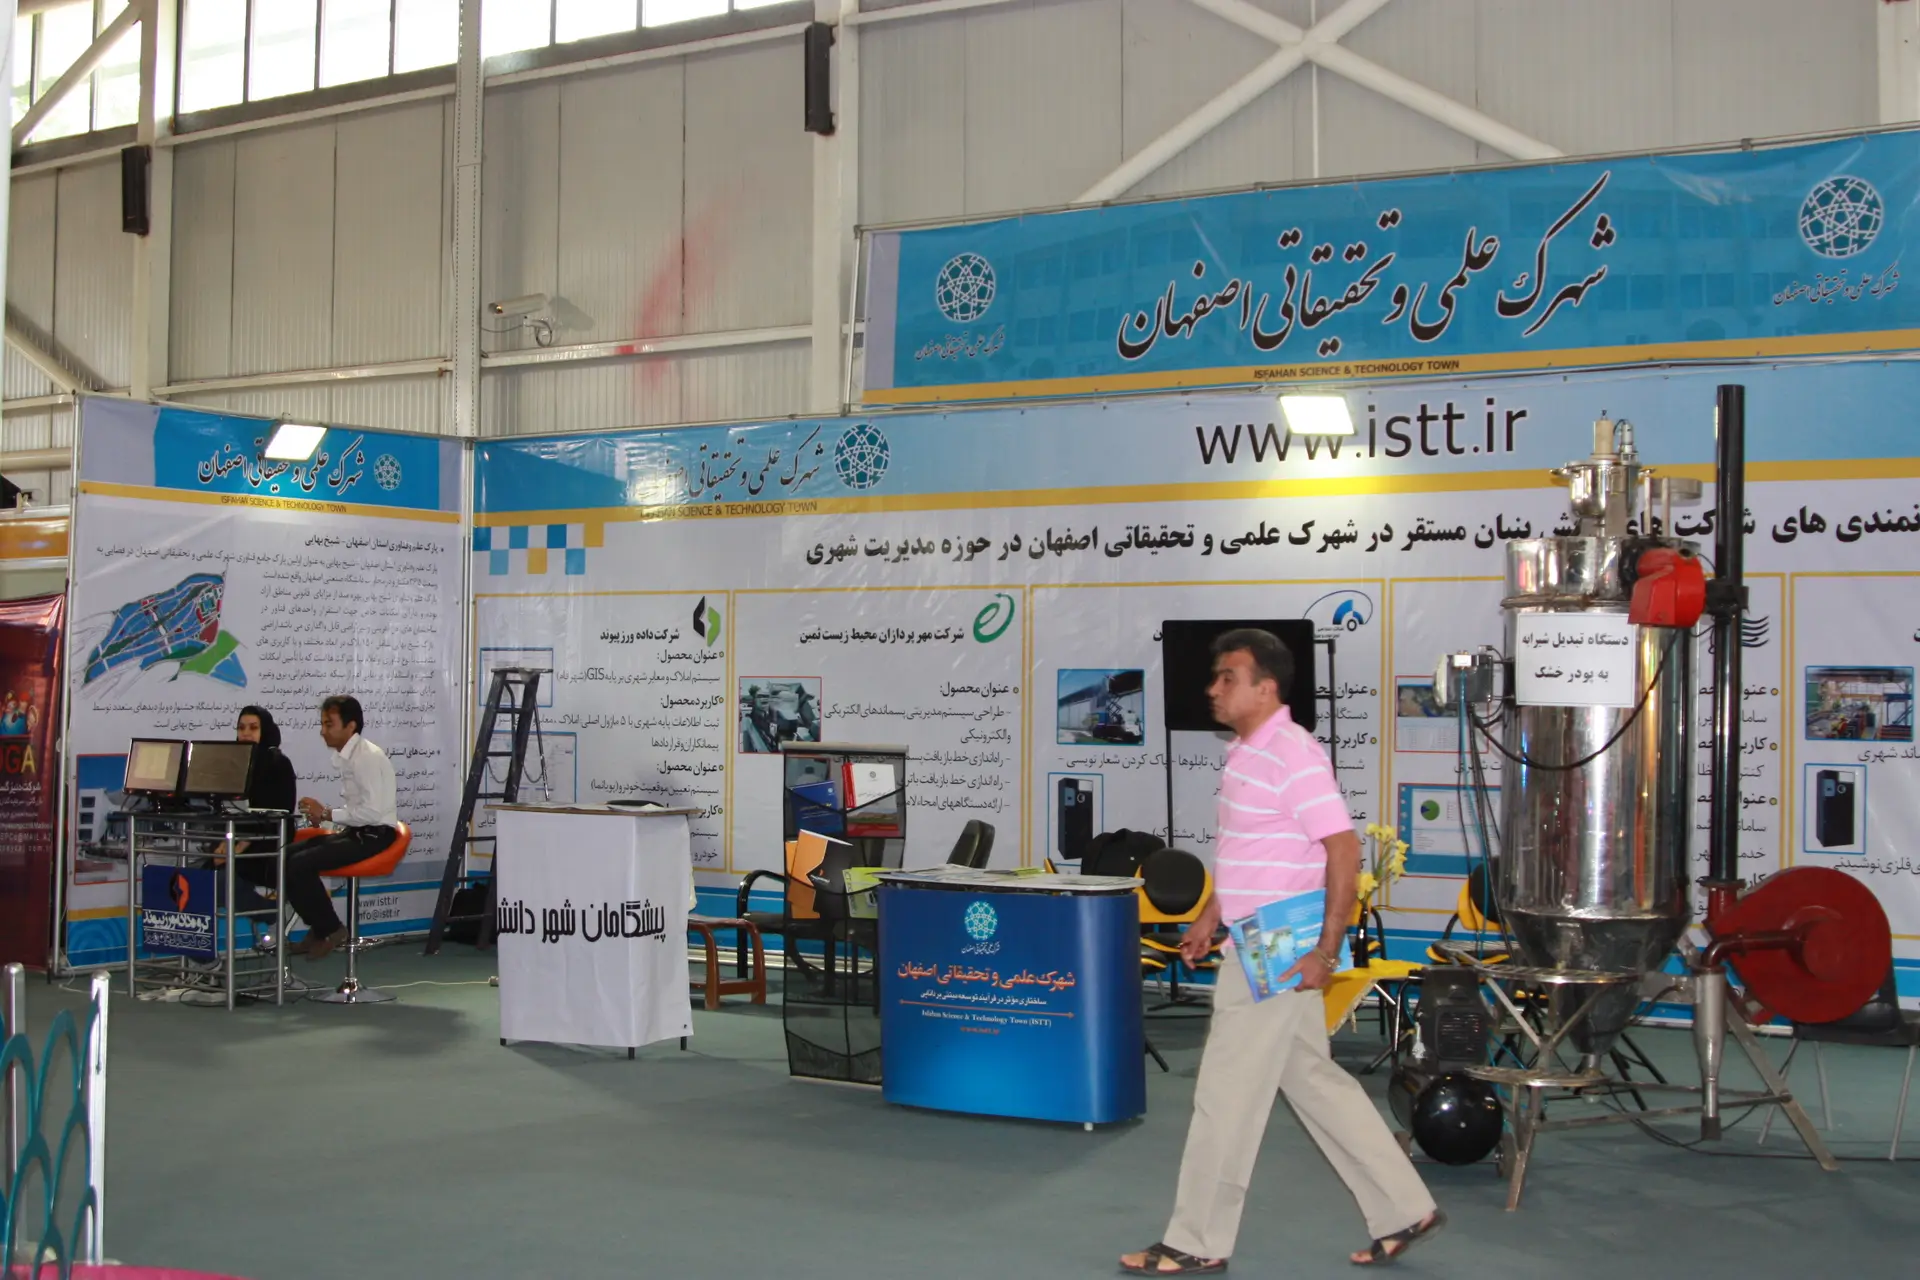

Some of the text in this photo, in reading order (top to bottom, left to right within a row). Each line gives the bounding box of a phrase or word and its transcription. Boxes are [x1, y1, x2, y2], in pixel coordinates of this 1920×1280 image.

[1117, 171, 1616, 359] شهرک علمی و تحقیقاتی اصفهان
[1254, 360, 1460, 379] ISFAHAN SCIENCE & TECHNOLOGY TOWN
[1196, 398, 1527, 465] www.istt.ir
[197, 443, 248, 484] اصفهان
[327, 434, 365, 496] شهرک
[688, 424, 824, 501] شهرک علمی و تحقیقاتی
[249, 497, 275, 508] SCIENCE
[283, 500, 325, 512] TECHNOLOGY
[326, 503, 347, 513] TOWN
[678, 500, 818, 517] SCIENCE & TECHNOLOGY TOWN
[1675, 508, 1756, 538] شکت
[1772, 505, 1827, 543] های
[1028, 525, 1099, 559] اصفهان
[1104, 523, 1196, 557] تحقیقاتی
[1201, 533, 1214, 555] و
[1220, 521, 1281, 555] علمی
[1288, 519, 1358, 552] شهرک
[1365, 522, 1394, 552] در
[1400, 517, 1467, 551] مستقر
[806, 533, 859, 565] شهری
[863, 536, 936, 564] مدیریت
[941, 535, 991, 562] حوزه
[997, 533, 1022, 561] در
[636, 628, 654, 640] داده
[654, 628, 680, 643] شرکت
[822, 630, 849, 644] زیست
[851, 628, 878, 643] محیط
[934, 626, 965, 643] شرکت
[1521, 632, 1550, 649] شیرابه
[1552, 632, 1585, 648] تبدیل
[693, 650, 718, 664] عنوان
[586, 667, 605, 681] GIS
[1534, 665, 1609, 684] به پودر خشک
[981, 682, 1010, 698] عنوان
[1743, 684, 1767, 701] عنو
[1335, 707, 1368, 720] دستگا
[1742, 710, 1767, 723] ساما
[1858, 746, 1898, 763] شهری
[693, 760, 718, 776] عنوان
[1739, 791, 1767, 809] عنوا
[541, 898, 577, 944] شهر
[897, 960, 1076, 992] شهرک علمی و تحقیقاتی اصفهان
